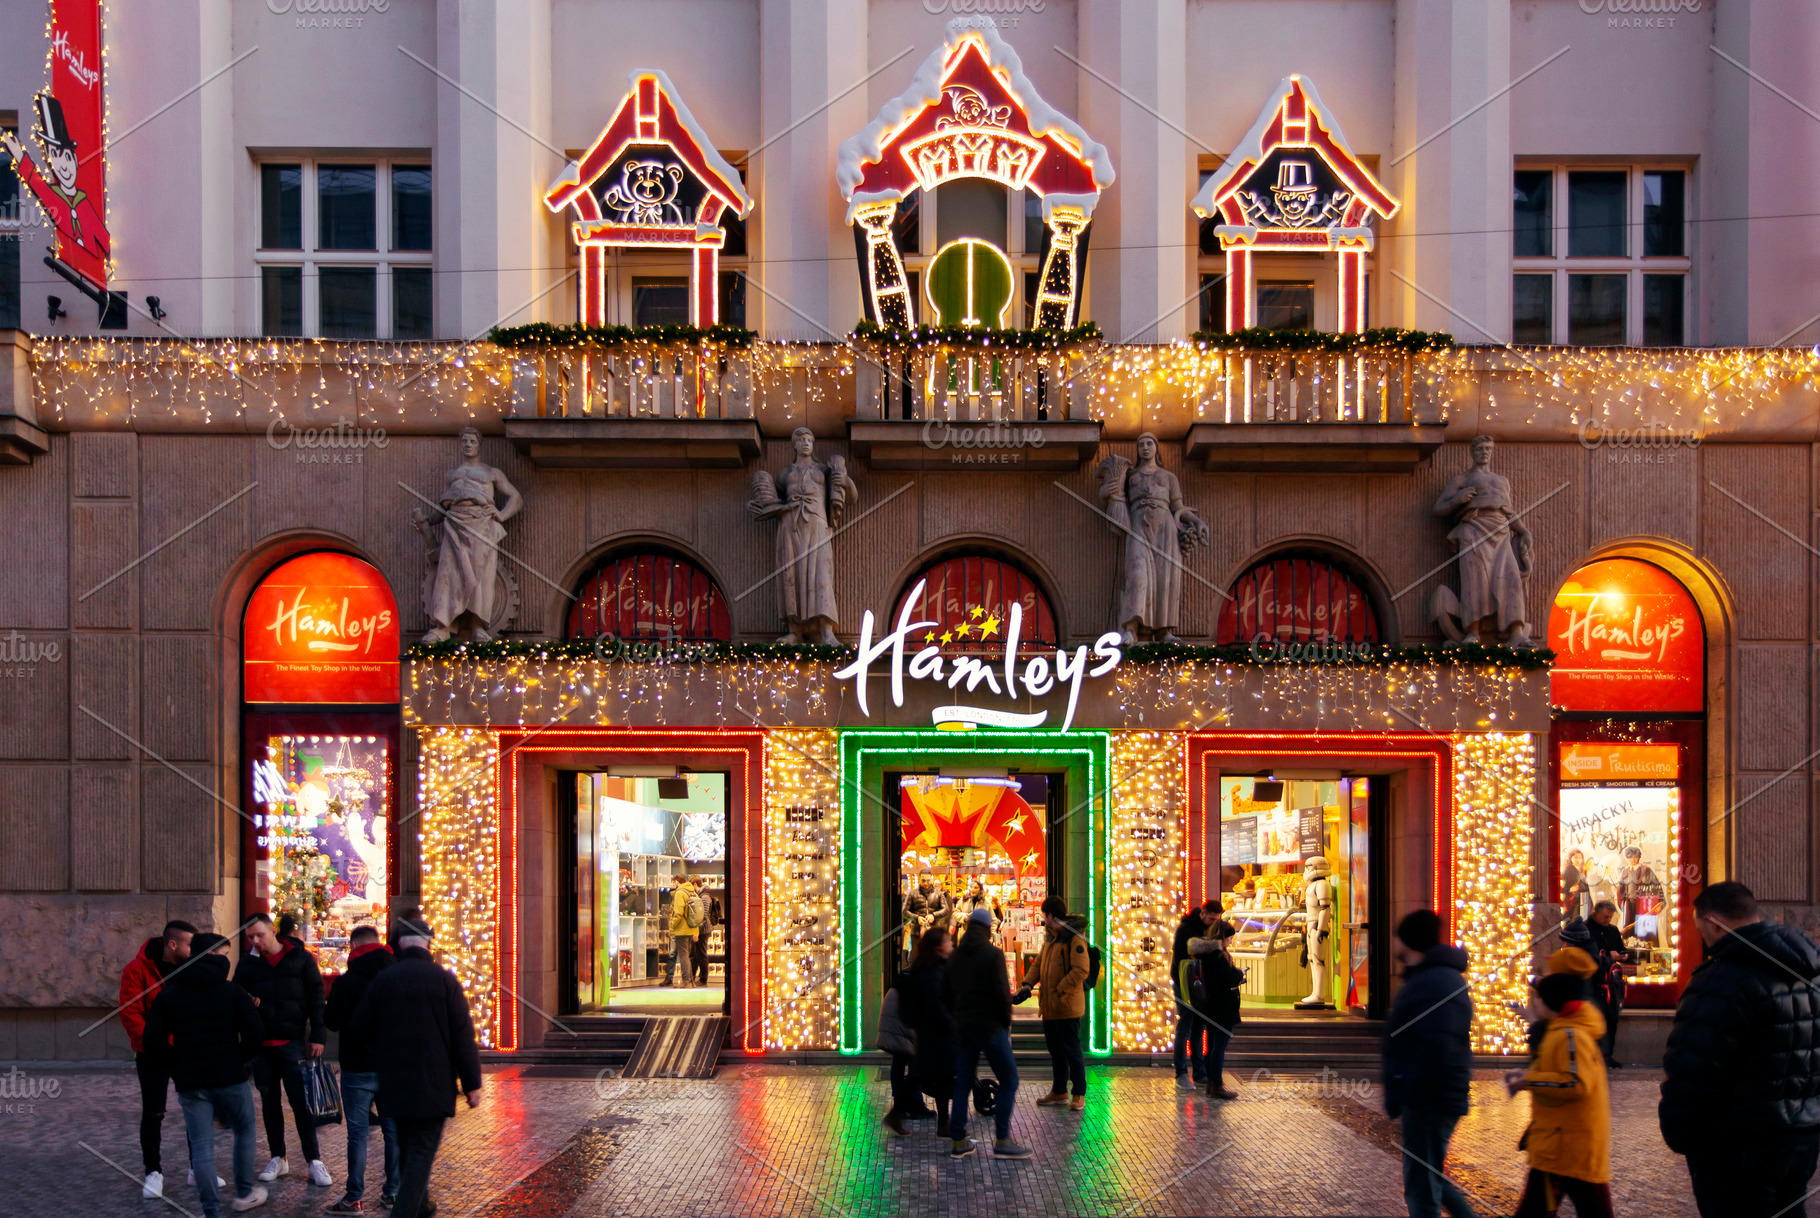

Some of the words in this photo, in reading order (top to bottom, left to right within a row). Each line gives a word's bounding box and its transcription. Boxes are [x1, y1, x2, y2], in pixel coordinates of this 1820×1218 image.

[53, 30, 98, 91] Hamleys
[266, 586, 391, 654] Hamleys
[591, 567, 716, 631] Hamleys
[1233, 571, 1357, 635] Hamleys
[1558, 594, 1684, 662] Hamleys
[833, 578, 1122, 734] Hamleys
[1603, 673, 1614, 681] Toy
[1616, 673, 1632, 681] Shop
[1567, 759, 1599, 768] INSIDE
